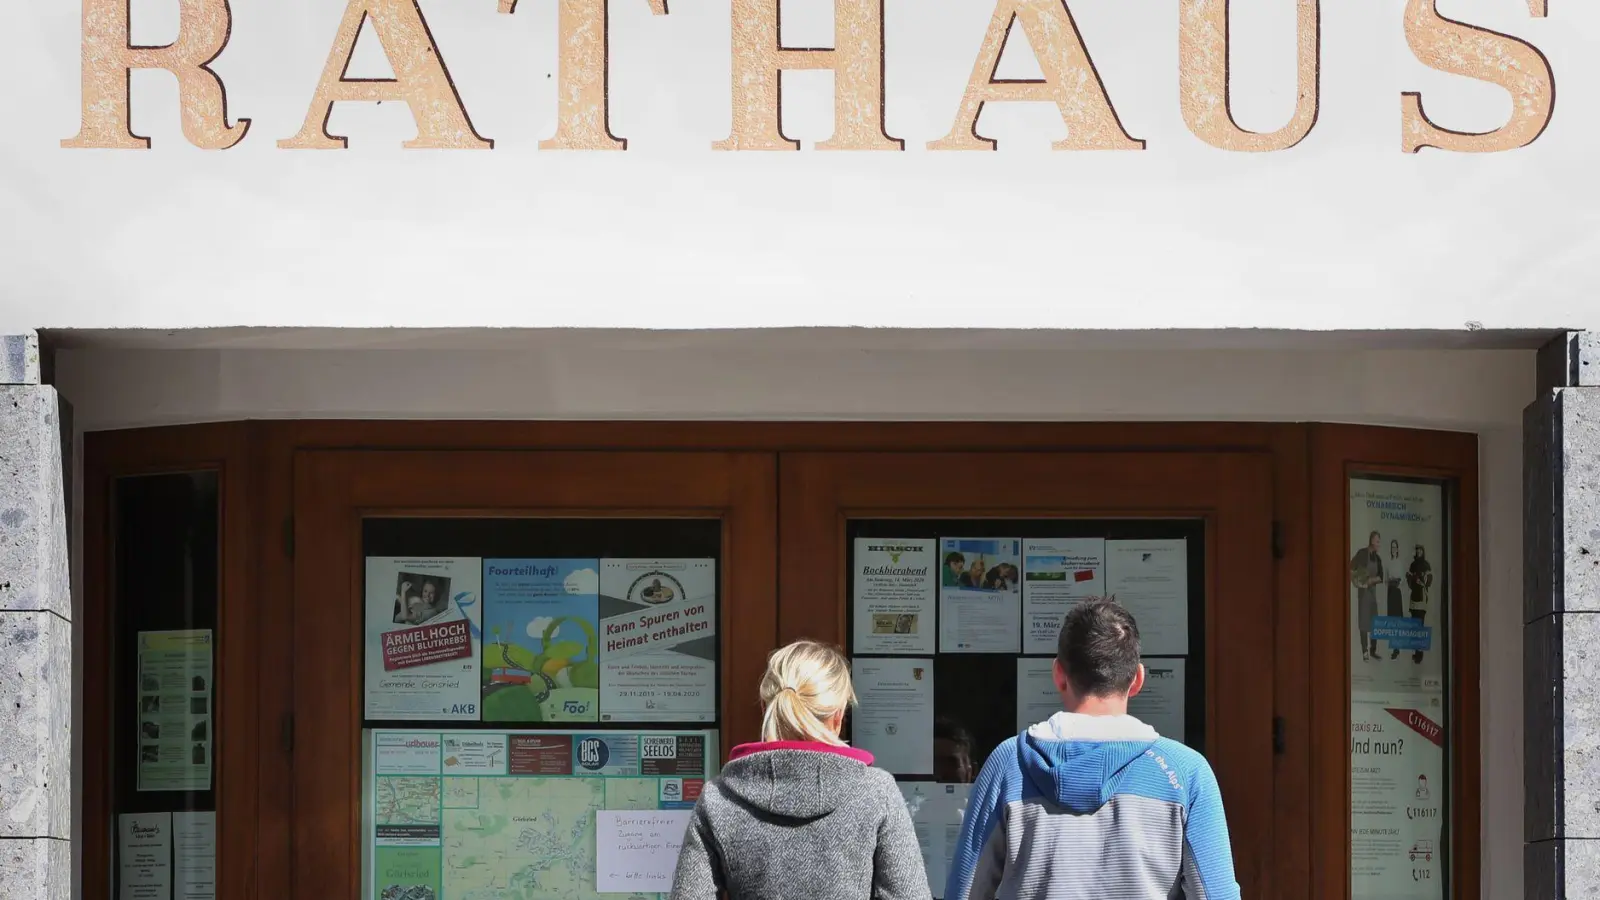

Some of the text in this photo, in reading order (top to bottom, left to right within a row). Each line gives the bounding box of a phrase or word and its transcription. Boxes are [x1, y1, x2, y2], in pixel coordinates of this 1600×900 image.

[59, 0, 1556, 153] RATHAUS
[488, 565, 559, 578] Foorteilhaft!
[863, 566, 928, 576] Bockbierabend
[606, 604, 704, 635] Kann Spuren von
[1043, 621, 1061, 629] März
[386, 623, 466, 646] ÄRMEL HOCH
[607, 620, 708, 652] Heimat enthalten
[387, 635, 468, 656] GEGEN BLUTKREBS!
[451, 704, 476, 714] AKB
[562, 701, 591, 714] Foo!
[1352, 721, 1385, 732] raxis zu.
[643, 745, 675, 757] SEELOS
[1374, 738, 1404, 755] nun?
[1413, 808, 1437, 818] 116117
[1418, 869, 1431, 879] 112
